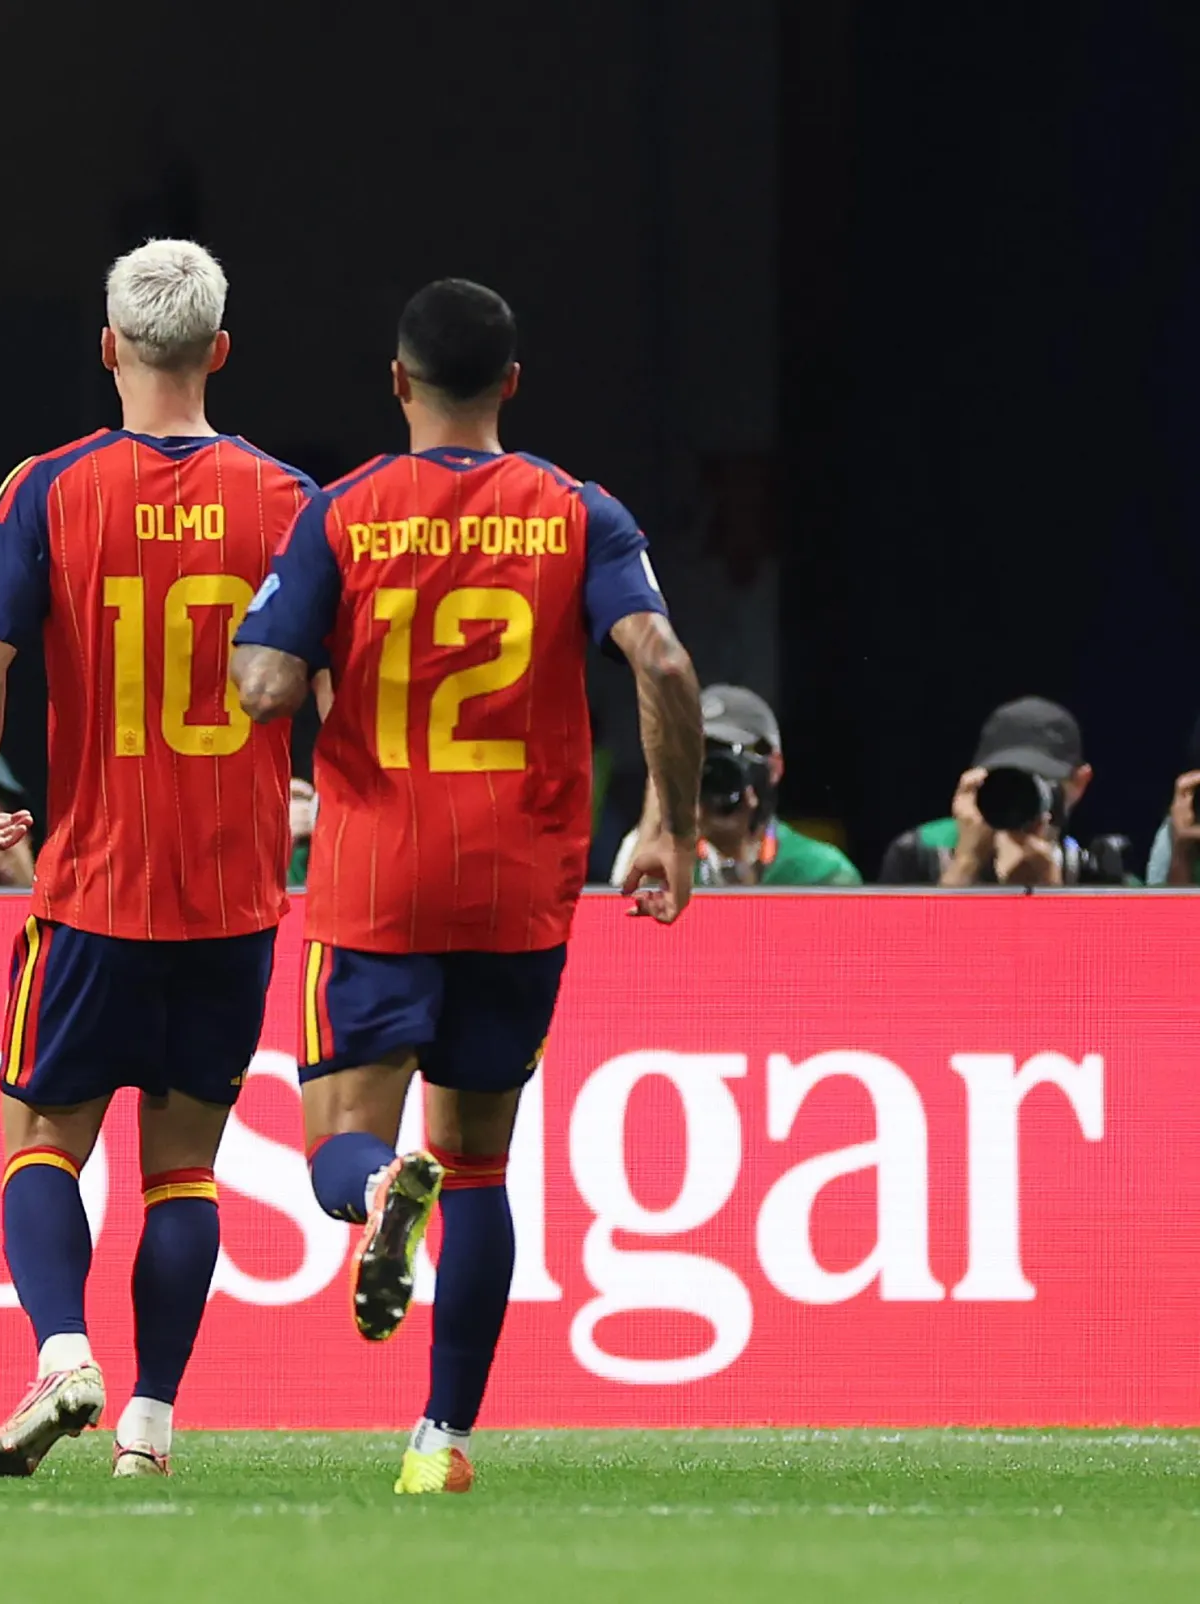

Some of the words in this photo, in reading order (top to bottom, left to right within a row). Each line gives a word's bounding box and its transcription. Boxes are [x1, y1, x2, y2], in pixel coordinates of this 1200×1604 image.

[135, 503, 225, 541] OLMO
[347, 516, 451, 563] PEDRO
[458, 515, 567, 557] PORRO
[103, 574, 256, 757] 10
[374, 587, 534, 773] 12
